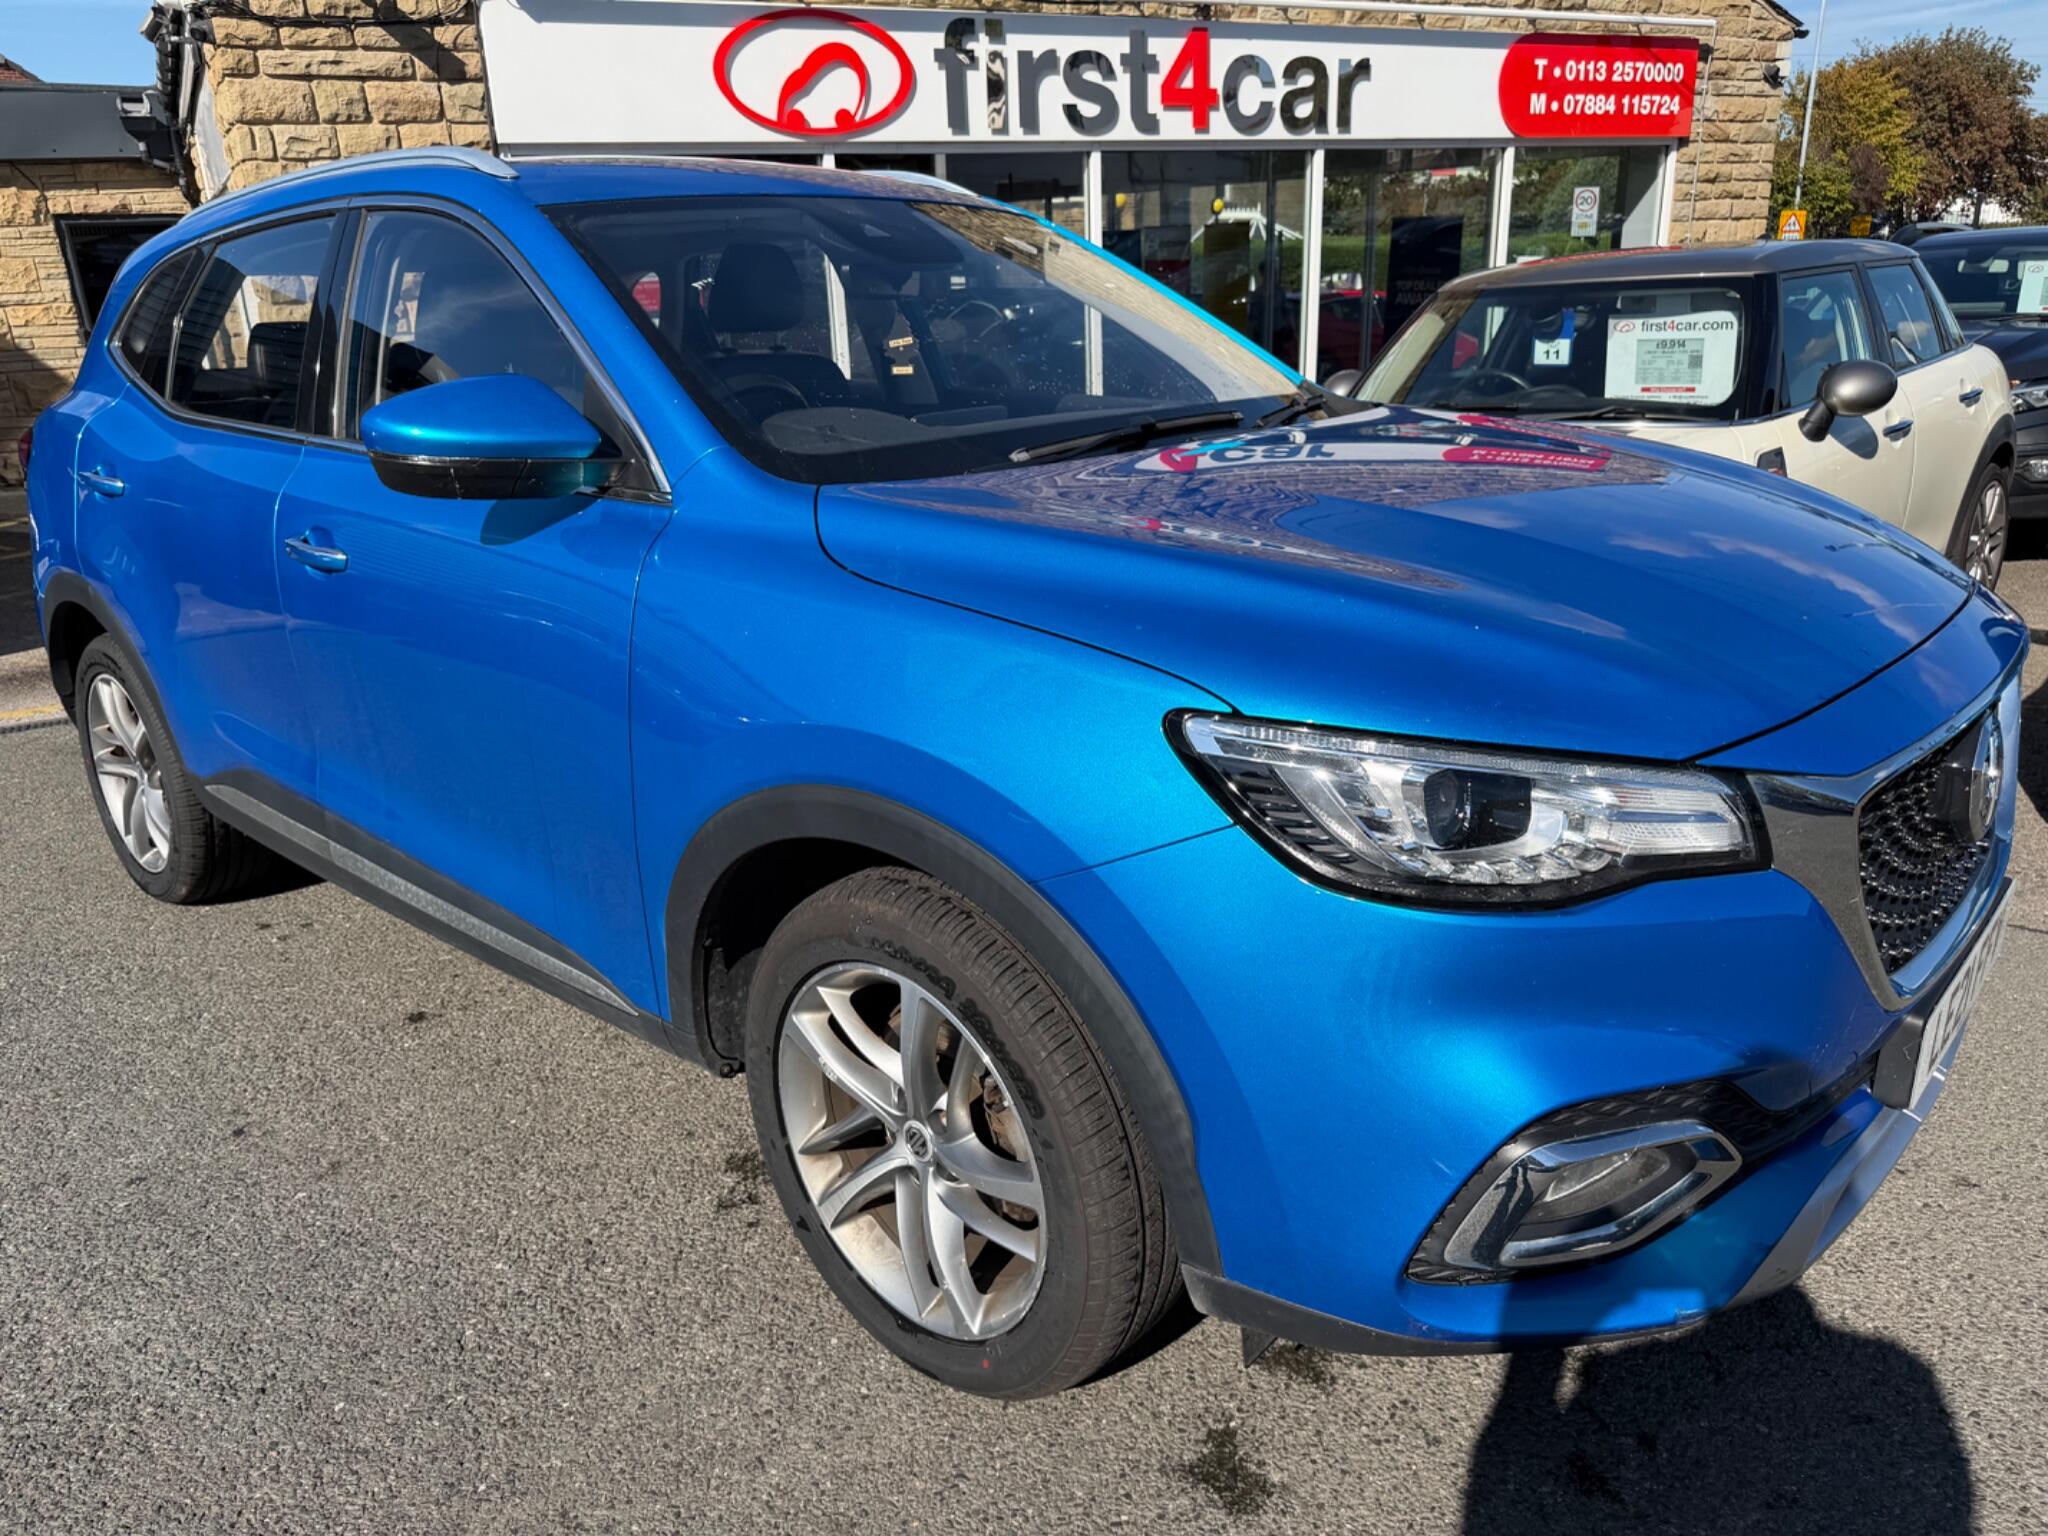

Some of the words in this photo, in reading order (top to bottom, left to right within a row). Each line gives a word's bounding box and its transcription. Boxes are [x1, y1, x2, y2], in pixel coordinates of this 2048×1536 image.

[934, 17, 1371, 136] first4car
[1533, 58, 1548, 81] T
[1565, 59, 1606, 82] 0113
[1611, 61, 1684, 83] 2570000
[1529, 92, 1547, 115] M
[1563, 94, 1616, 116] 07884
[1621, 95, 1680, 116] 115724
[1580, 195, 1593, 206] 20
[1641, 319, 1734, 332] first4car.com
[1542, 349, 1560, 360] 11
